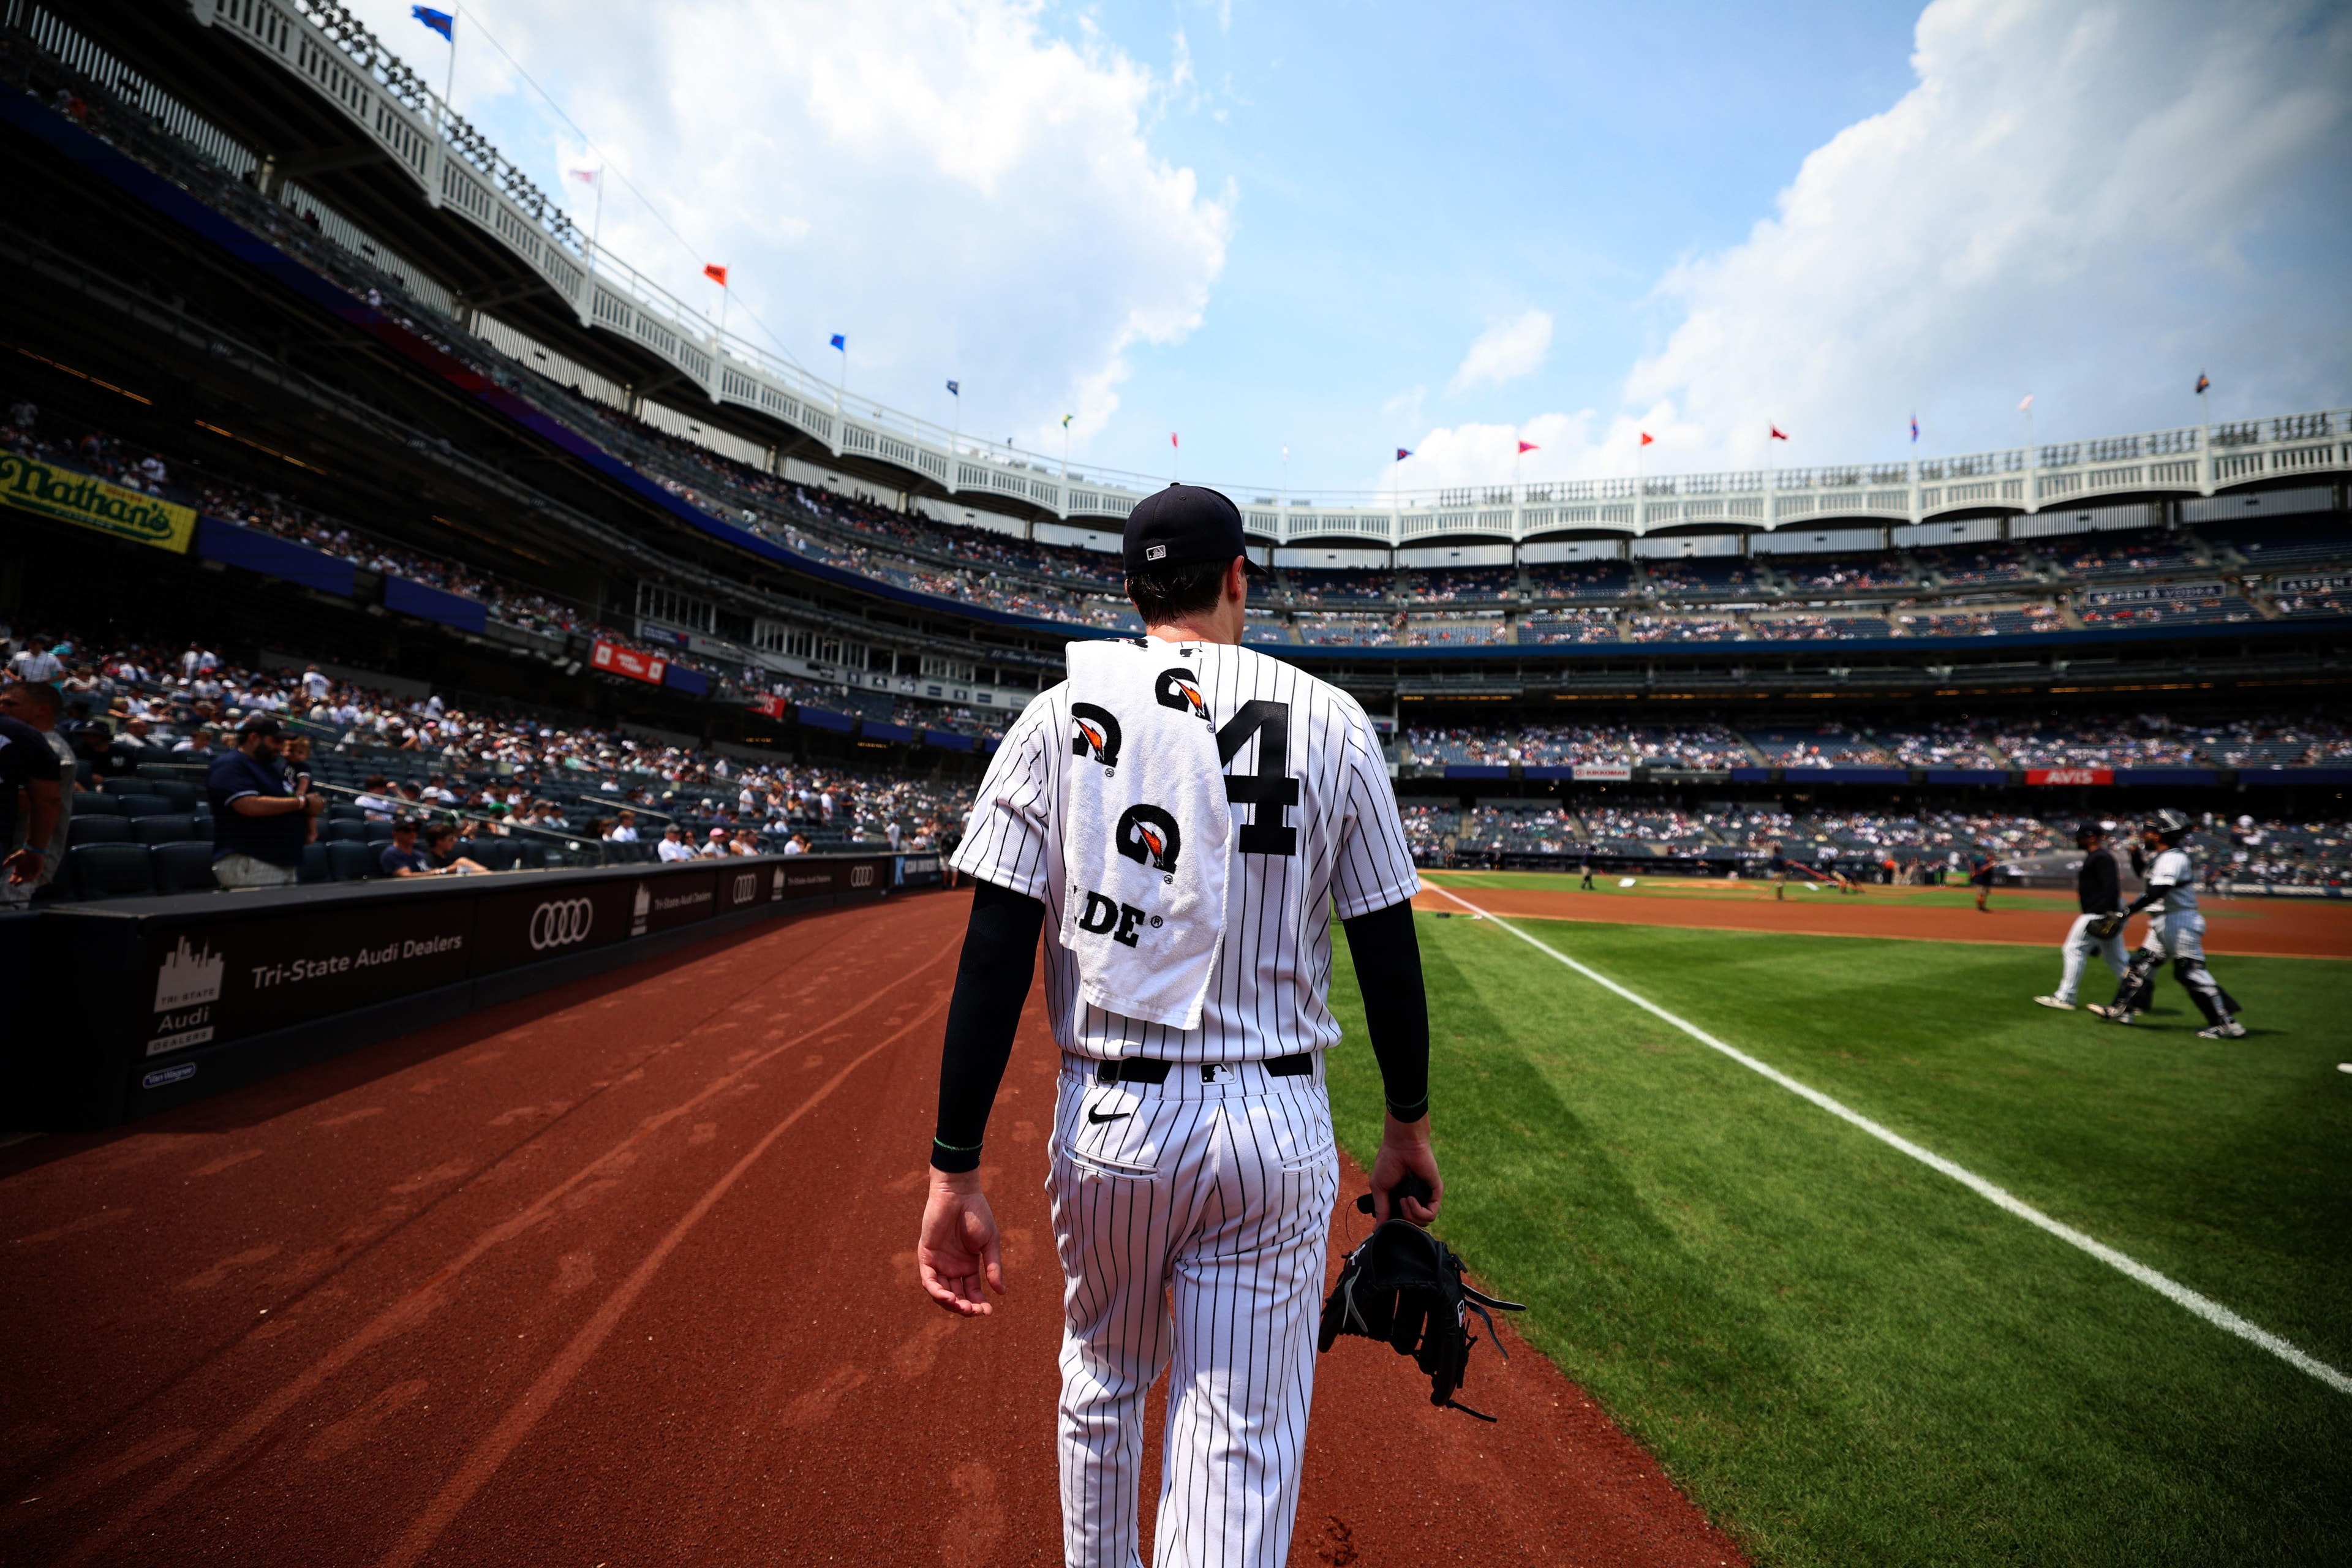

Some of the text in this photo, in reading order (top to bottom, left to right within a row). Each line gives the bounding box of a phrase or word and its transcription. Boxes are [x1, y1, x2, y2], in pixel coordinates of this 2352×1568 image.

[2045, 769, 2094, 785] AVIS
[251, 934, 464, 990] Tri-State Audi Dealers
[182, 987, 214, 1002] STATE
[157, 1005, 211, 1034] Audi
[153, 1030, 207, 1051] DEALERS
